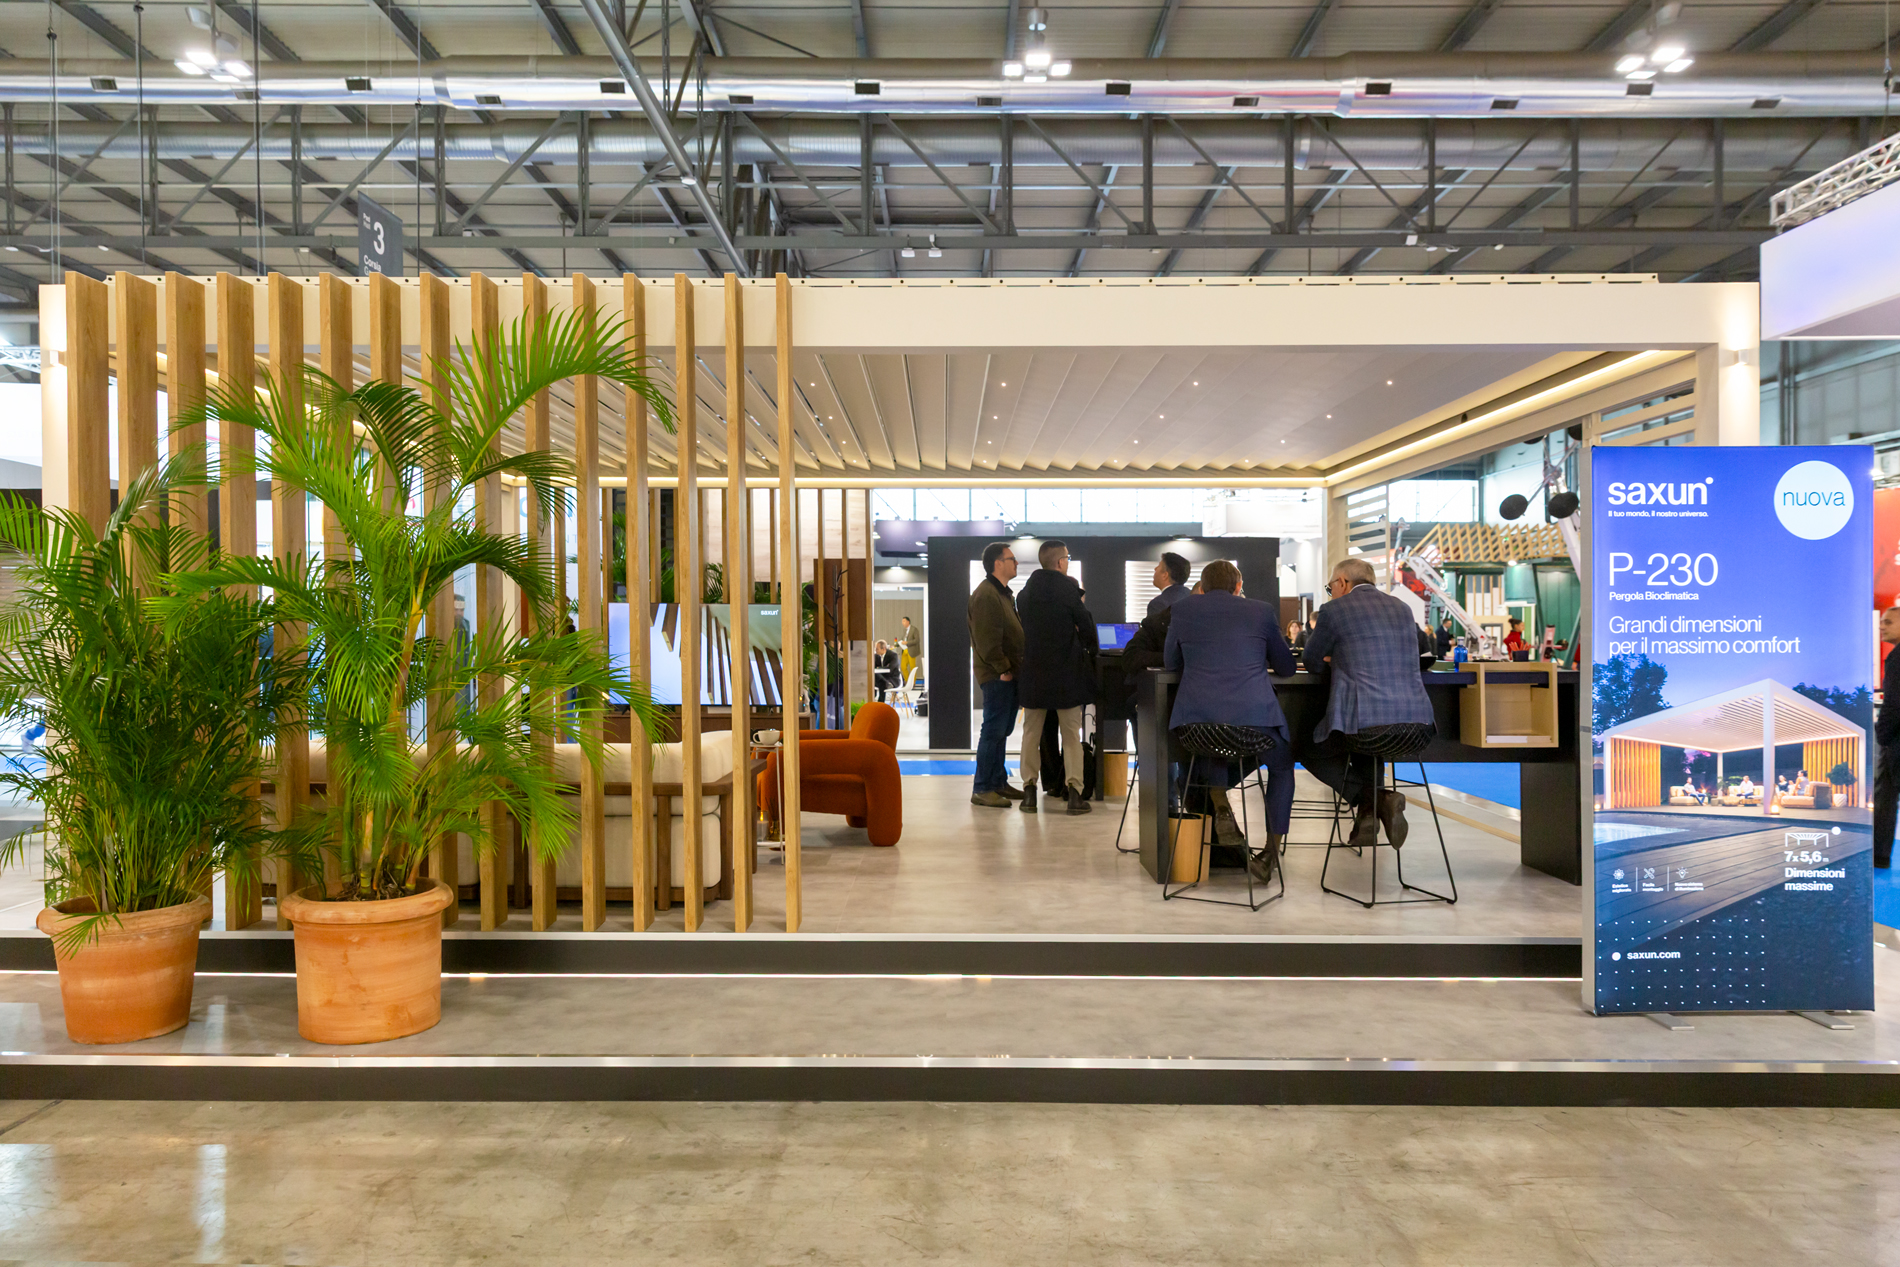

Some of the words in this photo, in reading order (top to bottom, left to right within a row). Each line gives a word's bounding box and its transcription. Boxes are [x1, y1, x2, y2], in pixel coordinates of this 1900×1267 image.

[373, 221, 385, 255] 3
[1607, 479, 1710, 506] saxun
[1783, 491, 1845, 506] nuova
[1626, 510, 1651, 518] mondo,
[1656, 510, 1678, 518] nostro
[1679, 510, 1709, 518] universo.
[1609, 552, 1719, 587] P-230
[1609, 591, 1644, 602] Pergola
[1645, 591, 1699, 601] Bioclimatica
[1609, 616, 1667, 634] Grandi
[1670, 615, 1762, 633] dimensioni
[1609, 640, 1637, 658] per
[1641, 637, 1648, 653] il
[1651, 637, 1730, 654] massimo
[1732, 636, 1801, 654] comfort
[1784, 867, 1846, 878] Dimensioni
[1784, 881, 1834, 891] massime
[1626, 951, 1681, 960] saxun.com
